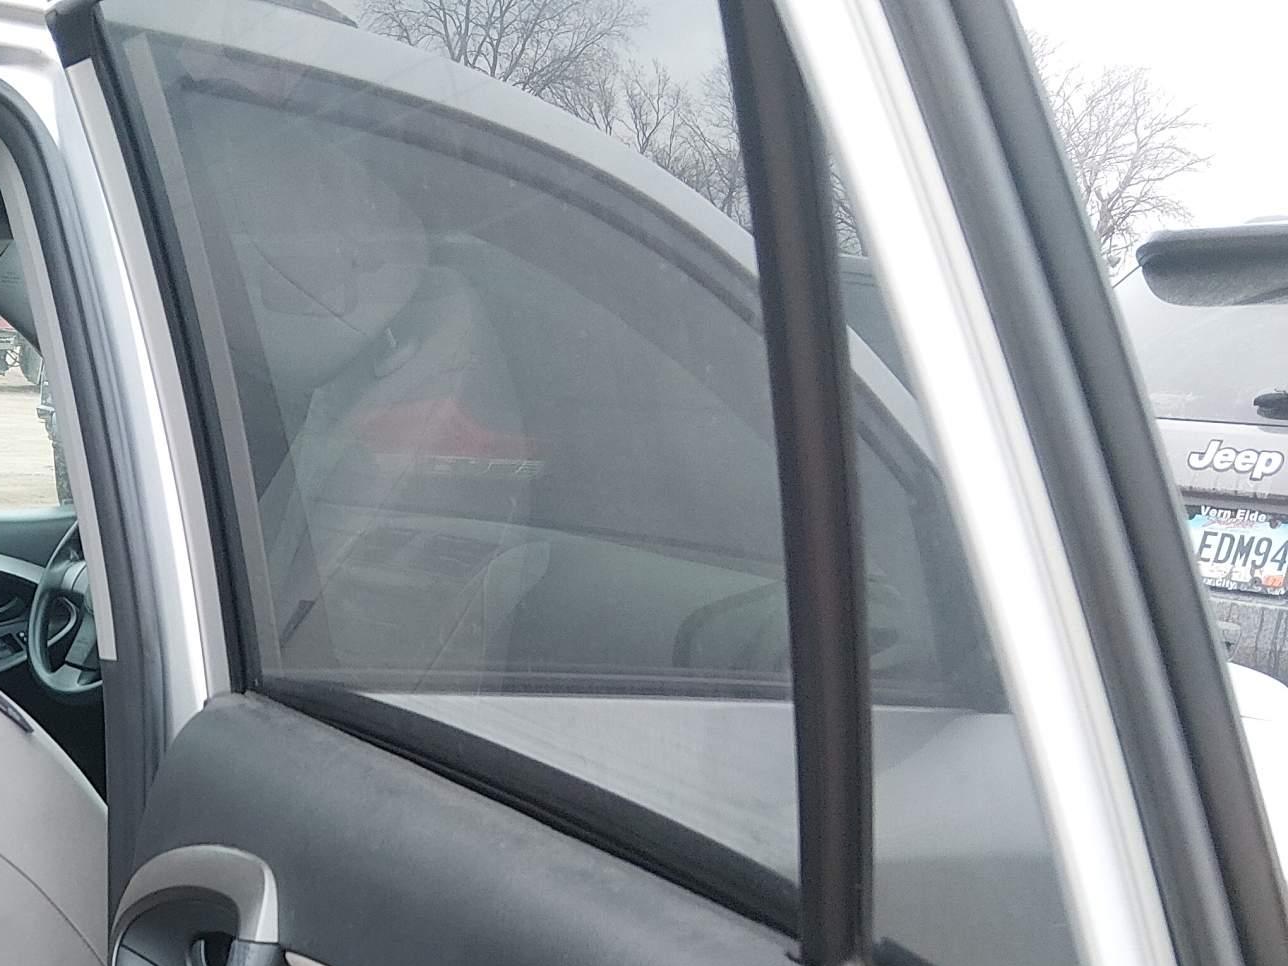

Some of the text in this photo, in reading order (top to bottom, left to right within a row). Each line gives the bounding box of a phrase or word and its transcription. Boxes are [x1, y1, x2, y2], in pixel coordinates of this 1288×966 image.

[1187, 439, 1285, 481] Jeep
[1200, 505, 1232, 520] Vern
[1198, 530, 1288, 571] EDM94
